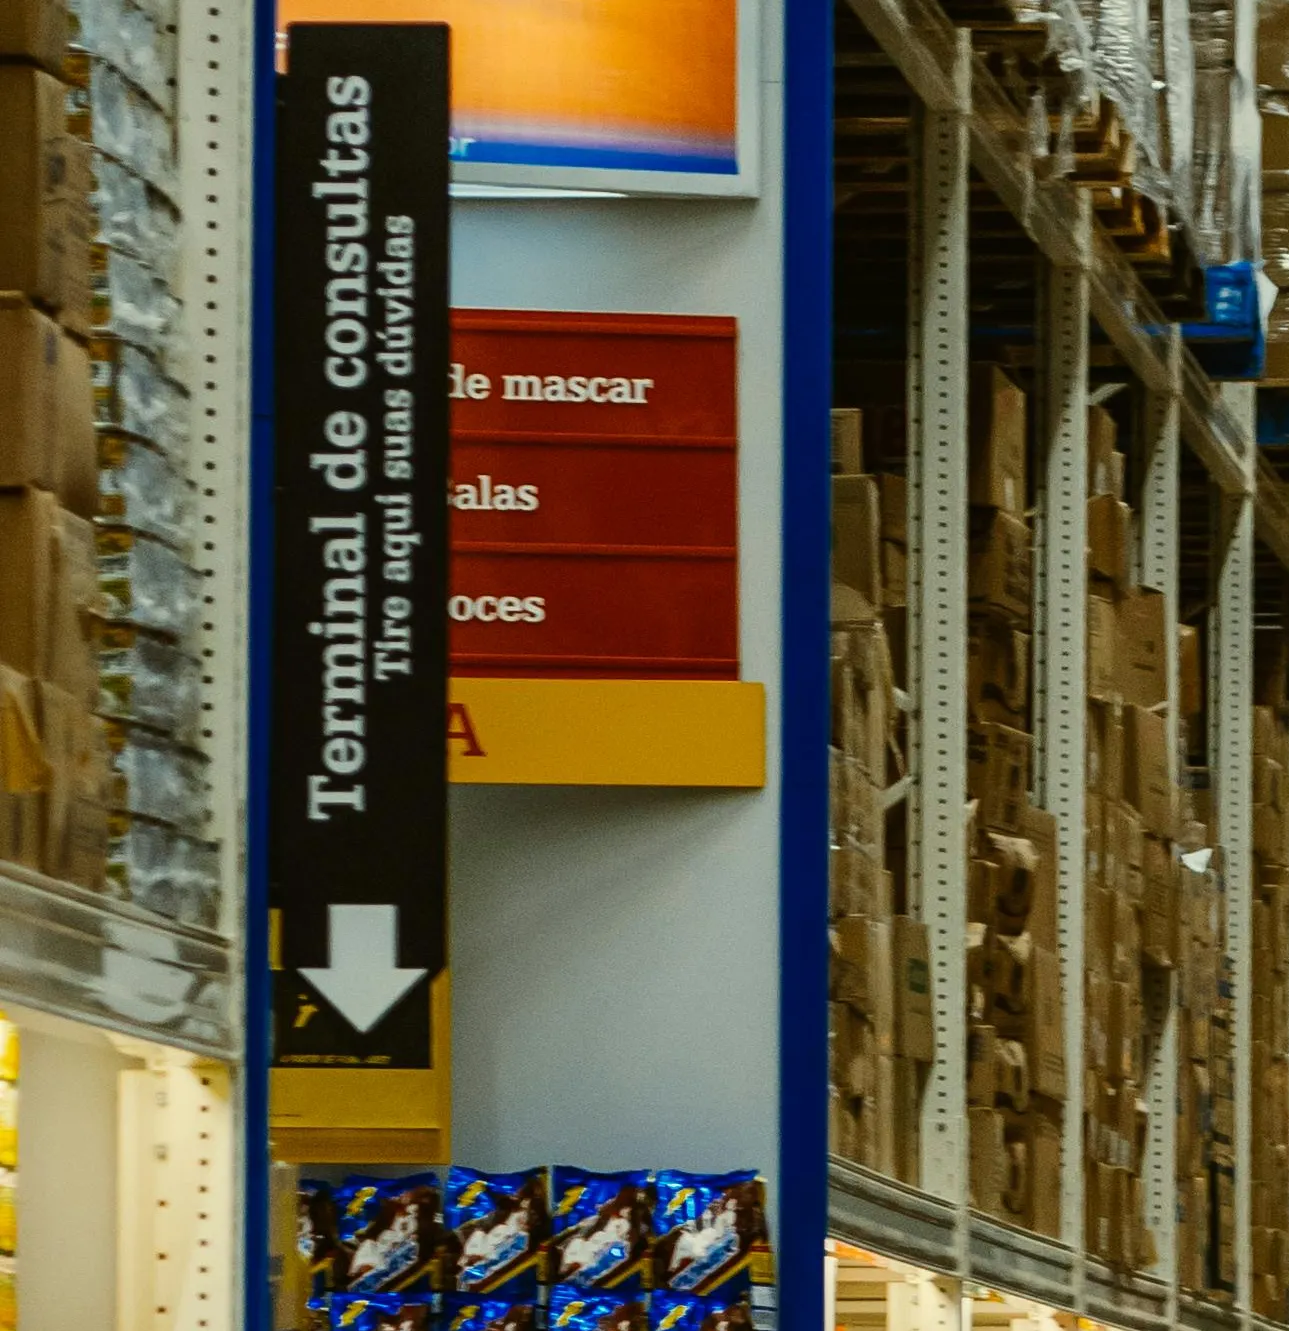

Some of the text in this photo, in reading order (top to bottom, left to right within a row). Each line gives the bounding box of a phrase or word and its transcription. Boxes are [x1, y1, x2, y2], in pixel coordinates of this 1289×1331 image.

[307, 75, 372, 821] Terminal de consultas
[374, 215, 422, 681] Tire aqui suas dúvidas
[447, 474, 540, 511] alas
[501, 374, 654, 404] mascar
